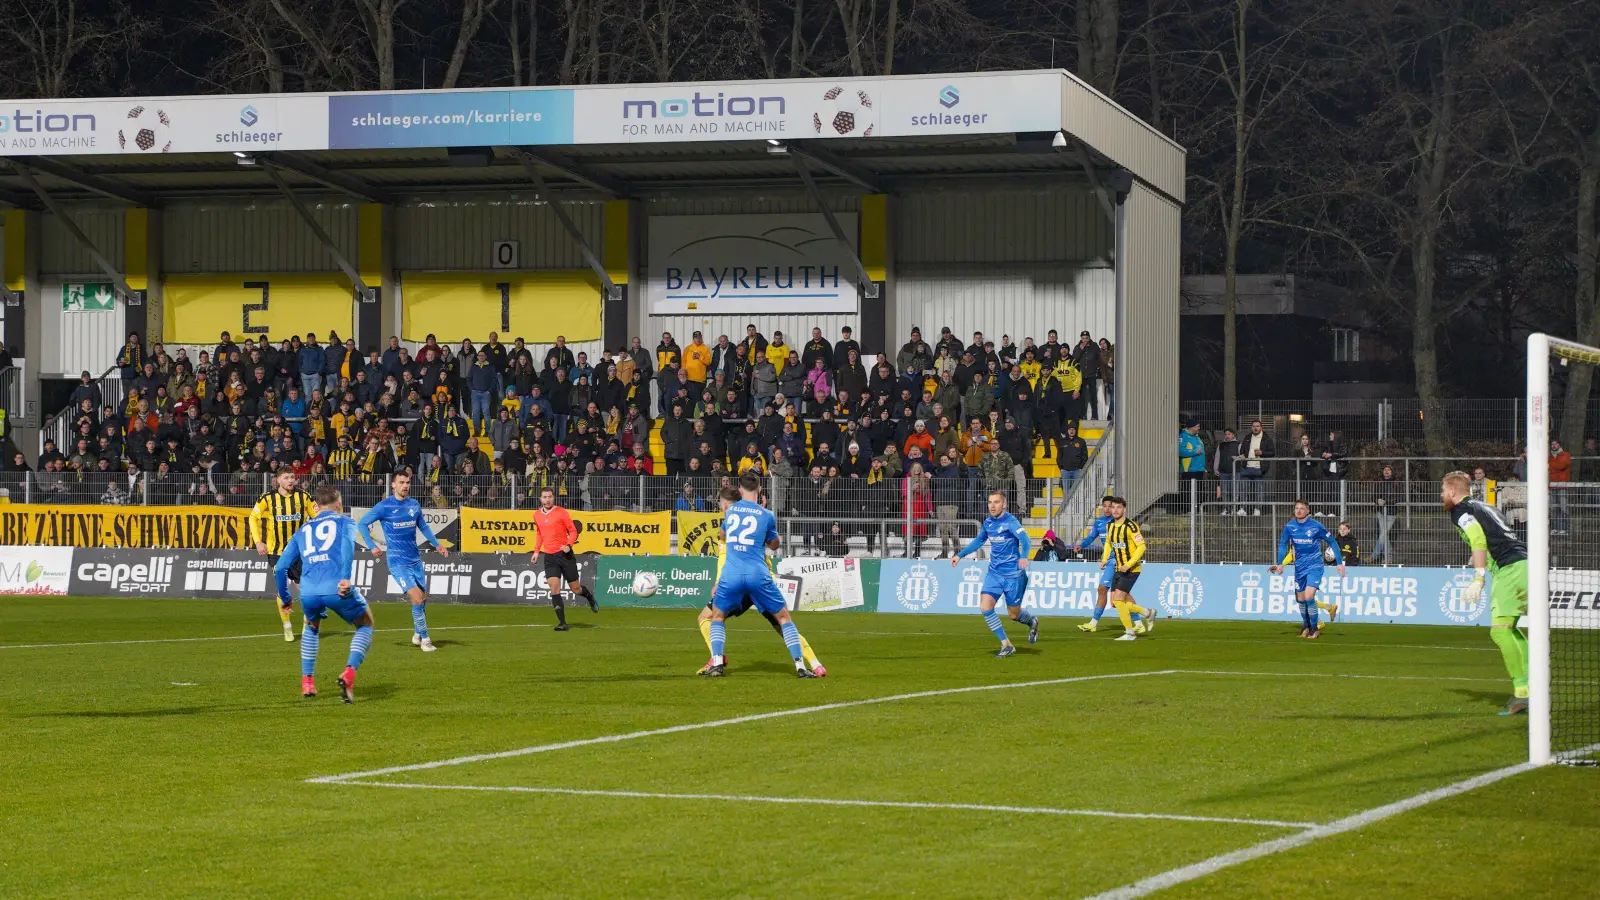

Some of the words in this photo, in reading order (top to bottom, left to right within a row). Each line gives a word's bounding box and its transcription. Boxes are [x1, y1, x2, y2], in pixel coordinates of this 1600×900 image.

[623, 92, 785, 118] motion
[352, 109, 542, 128] schlaeger.com/karriere
[622, 124, 648, 136] FOR
[654, 123, 684, 135] MAN
[690, 122, 718, 133] AND
[725, 120, 786, 133] MACHINE
[911, 112, 988, 127] schlaeger
[11, 138, 37, 149] AND
[42, 137, 96, 148] MACHINE
[215, 130, 283, 145] schlaeger
[497, 242, 515, 265] 0
[666, 265, 839, 298] BAYREUTH
[242, 281, 269, 333] 2
[496, 282, 510, 333] 1
[35, 510, 238, 549] ZÄHNE-SCHWARZES
[470, 520, 536, 531] ALTSTADT
[587, 522, 660, 534] KULMBACH
[683, 521, 708, 551] BIEST
[725, 513, 758, 546] 22
[301, 520, 337, 557] 19
[481, 535, 526, 546] BANDE
[605, 538, 641, 549] LAND
[77, 556, 174, 589] capelli
[187, 557, 269, 571] capellisport.eu
[608, 569, 632, 579] Dein
[670, 567, 712, 580] Überall.
[801, 560, 838, 574] KURIER
[119, 583, 171, 593] SPORT
[607, 583, 634, 594] Auch
[655, 584, 700, 598] E-Paper.
[896, 571, 920, 611] BAYREUTHER
[1269, 575, 1418, 595] BAREUTHER
[1157, 576, 1184, 616] BAYREUTHER
[1185, 576, 1204, 615] BRAUHAUS
[1438, 580, 1466, 623] BAYREUTHER
